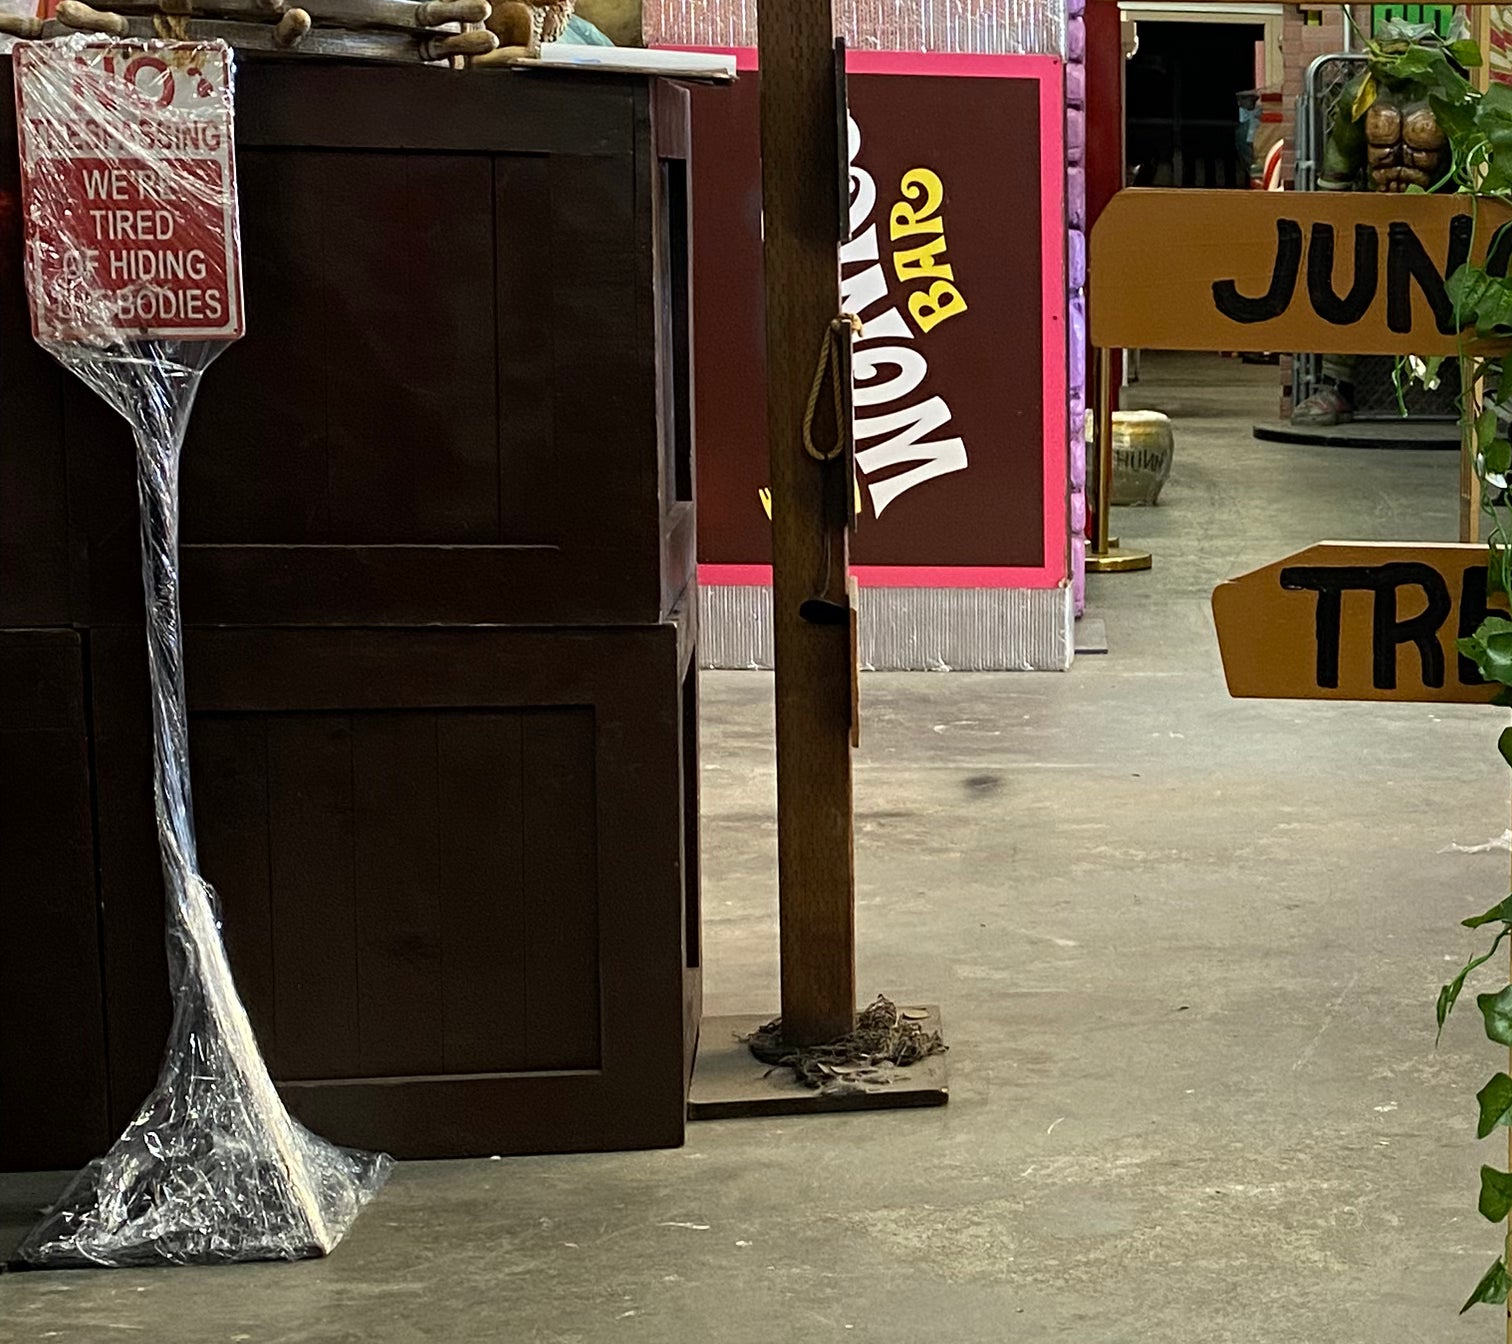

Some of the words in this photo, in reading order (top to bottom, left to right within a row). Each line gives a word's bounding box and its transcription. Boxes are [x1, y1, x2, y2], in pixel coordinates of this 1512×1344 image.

[90, 210, 174, 240] TIRED
[110, 249, 206, 280] HIDING
[890, 168, 968, 334] BAR
[117, 288, 222, 320] BODIES
